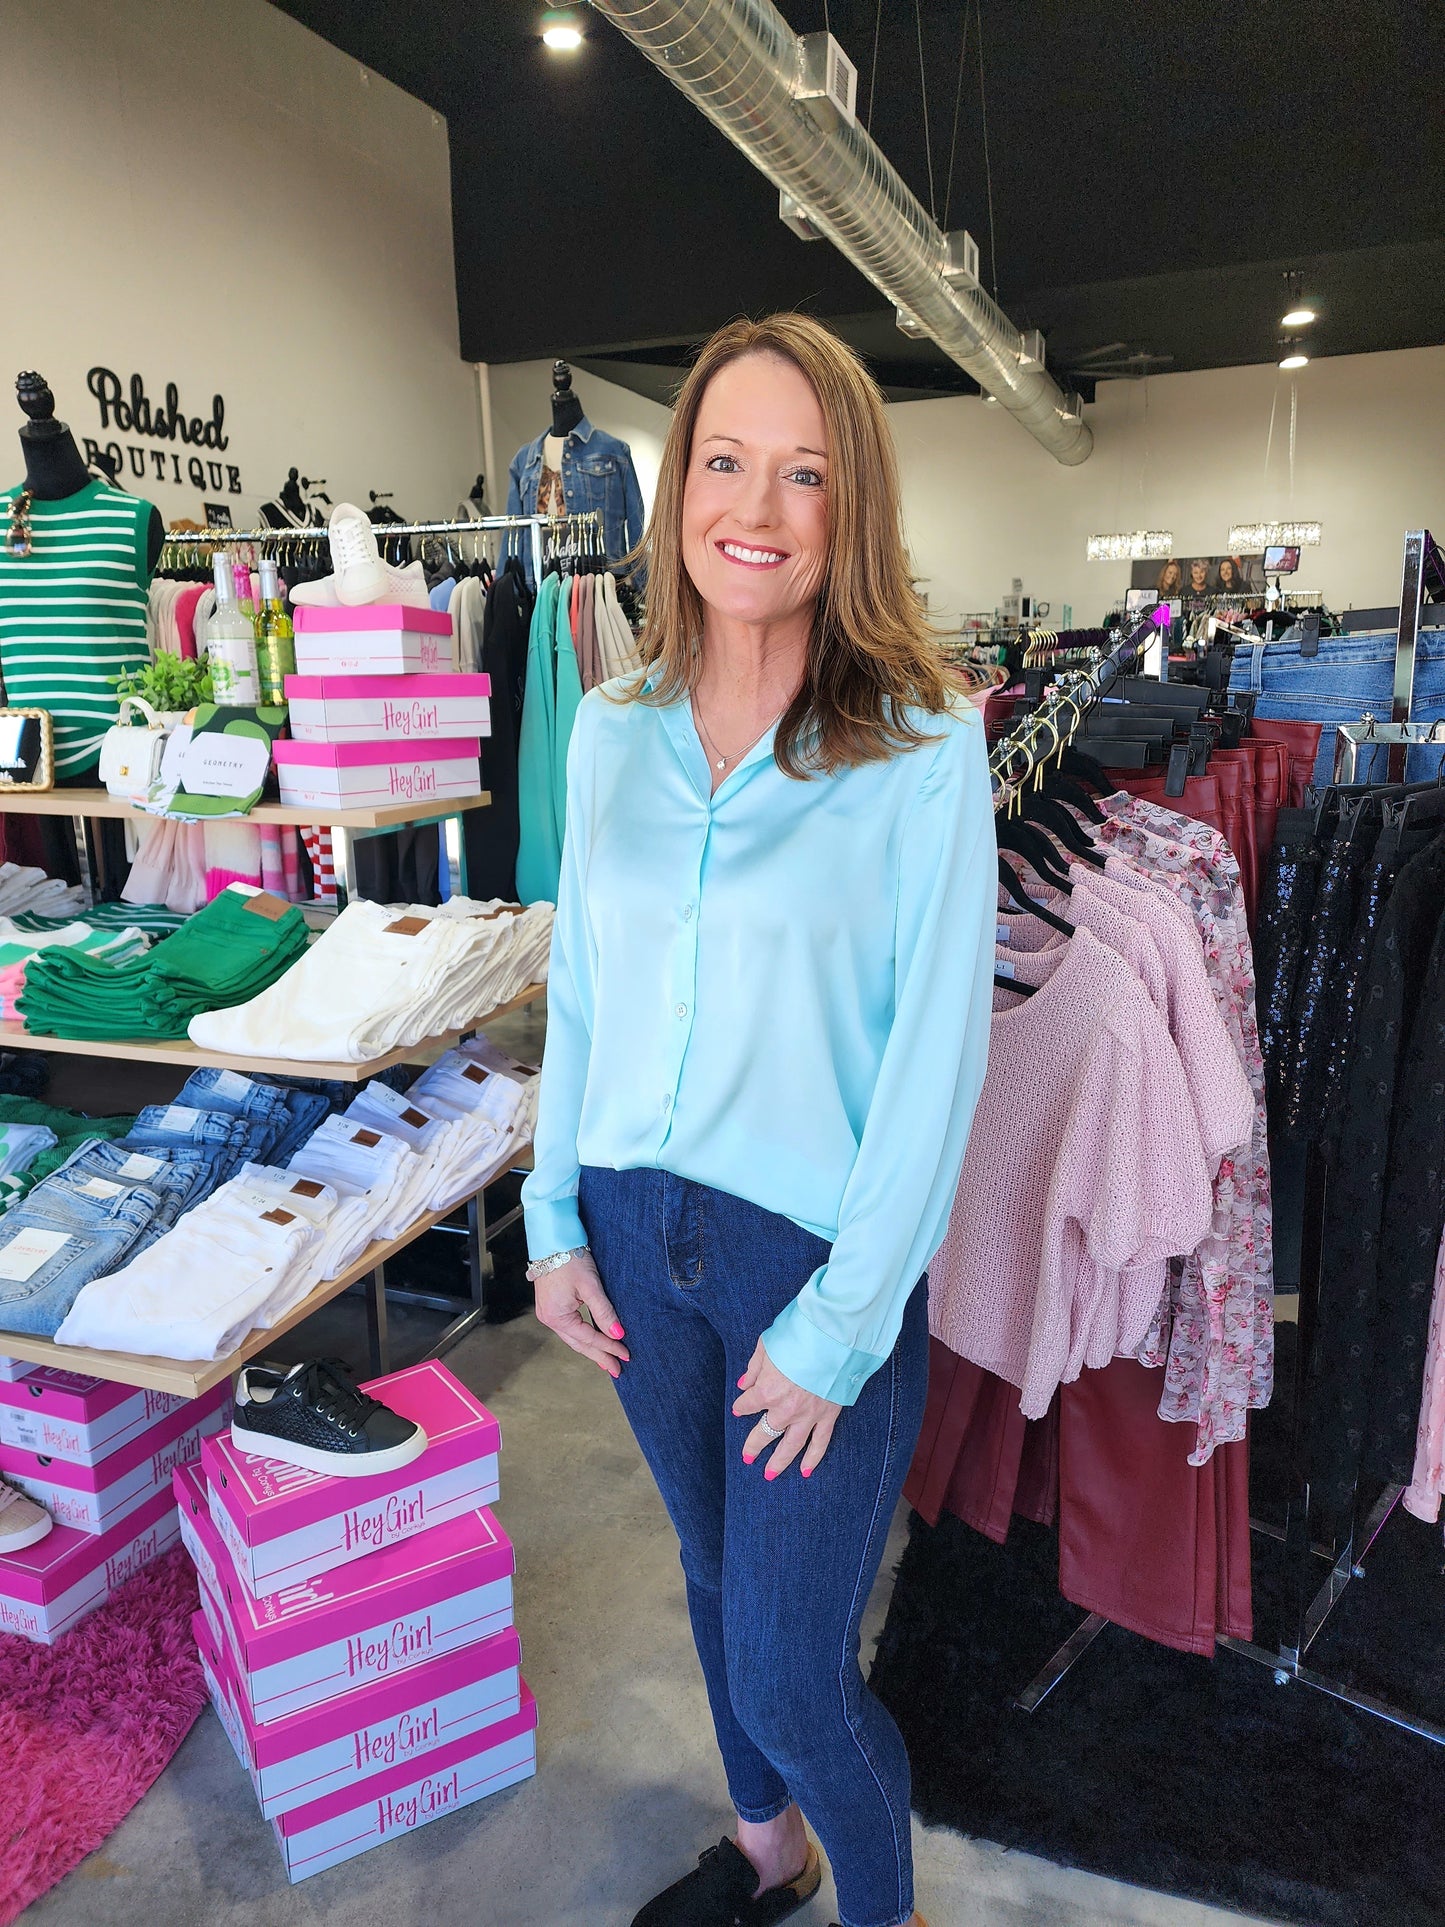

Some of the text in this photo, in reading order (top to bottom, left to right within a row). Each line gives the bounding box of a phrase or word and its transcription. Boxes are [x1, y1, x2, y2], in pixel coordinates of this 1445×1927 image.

[87, 366, 229, 452] Polished
[82, 437, 242, 494] BOUTIQUE
[381, 701, 438, 735] HeyGirl
[388, 765, 436, 799] HeyGirl
[43, 1422, 80, 1453] HeyGirl
[152, 1428, 201, 1485] HeyGirl
[52, 1493, 90, 1522] HeyGirl
[258, 1475, 275, 1497] Corkys
[340, 1490, 424, 1551] HeyGirl
[391, 1521, 426, 1539] by Corkys
[105, 1529, 157, 1590] HeyGirl
[0, 1603, 39, 1632] HeyGirl
[343, 1615, 432, 1677] HeyGirl
[408, 1648, 434, 1661] Corkys
[350, 1707, 438, 1770] HeyGirl
[374, 1772, 458, 1834] HeyGirl
